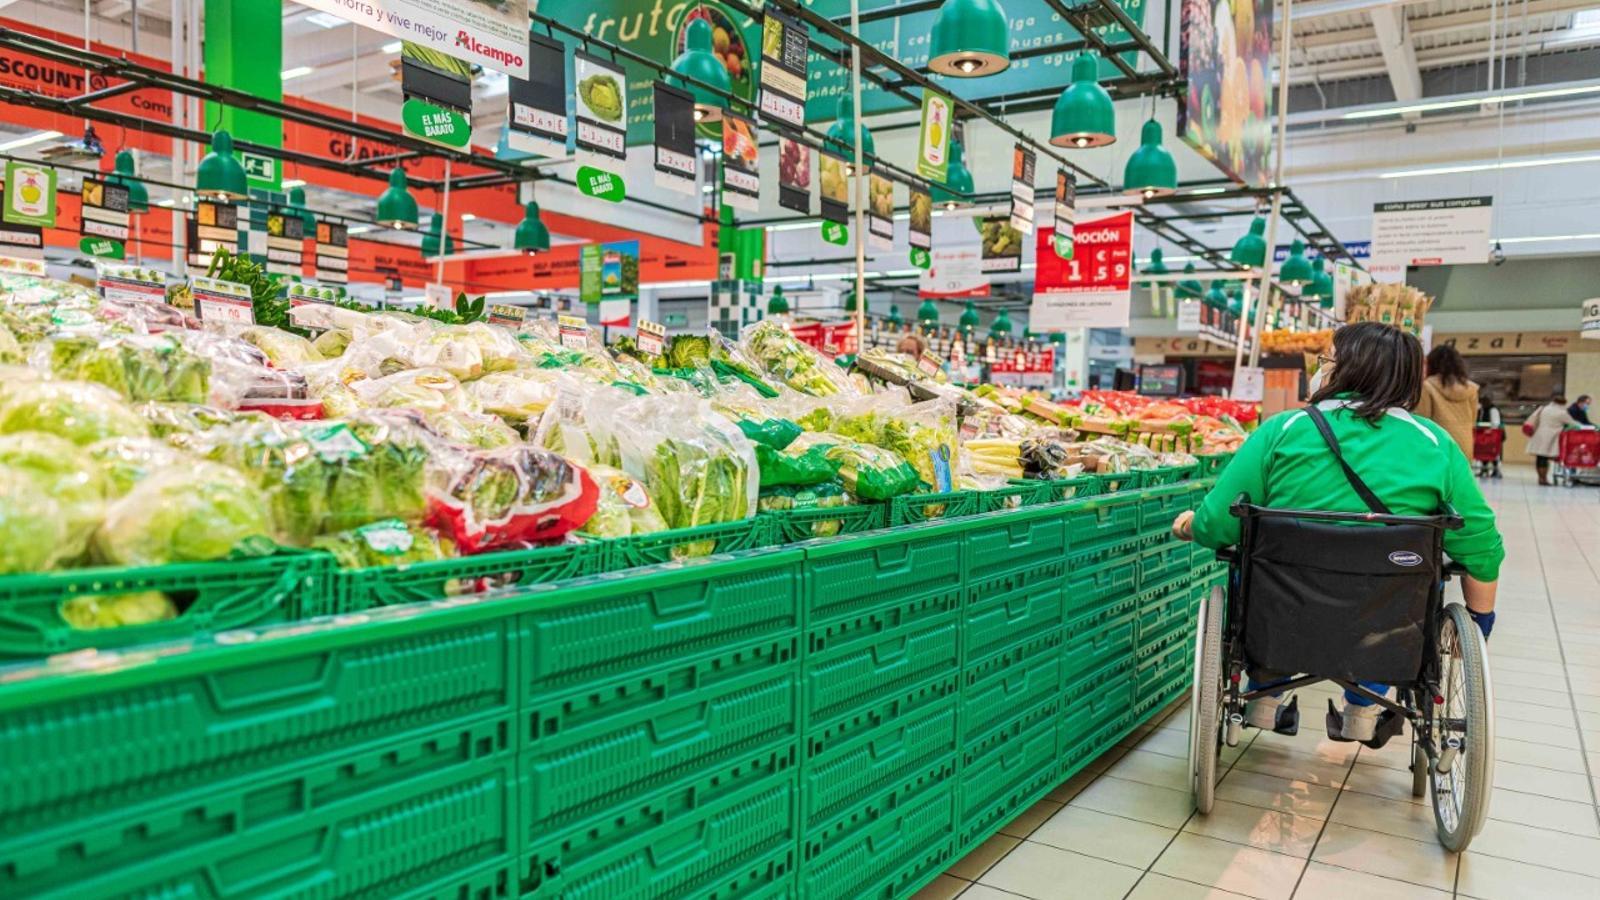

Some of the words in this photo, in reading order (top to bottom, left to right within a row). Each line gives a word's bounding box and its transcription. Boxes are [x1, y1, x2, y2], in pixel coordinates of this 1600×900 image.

[376, 9, 384, 22] y
[386, 11, 411, 30] vive
[414, 21, 448, 42] mejor
[455, 30, 523, 67] Alcampo
[422, 114, 432, 126] EL
[433, 110, 452, 124] MÁS
[425, 123, 455, 137] BARATO
[1048, 229, 1120, 246] PMOCIÓN
